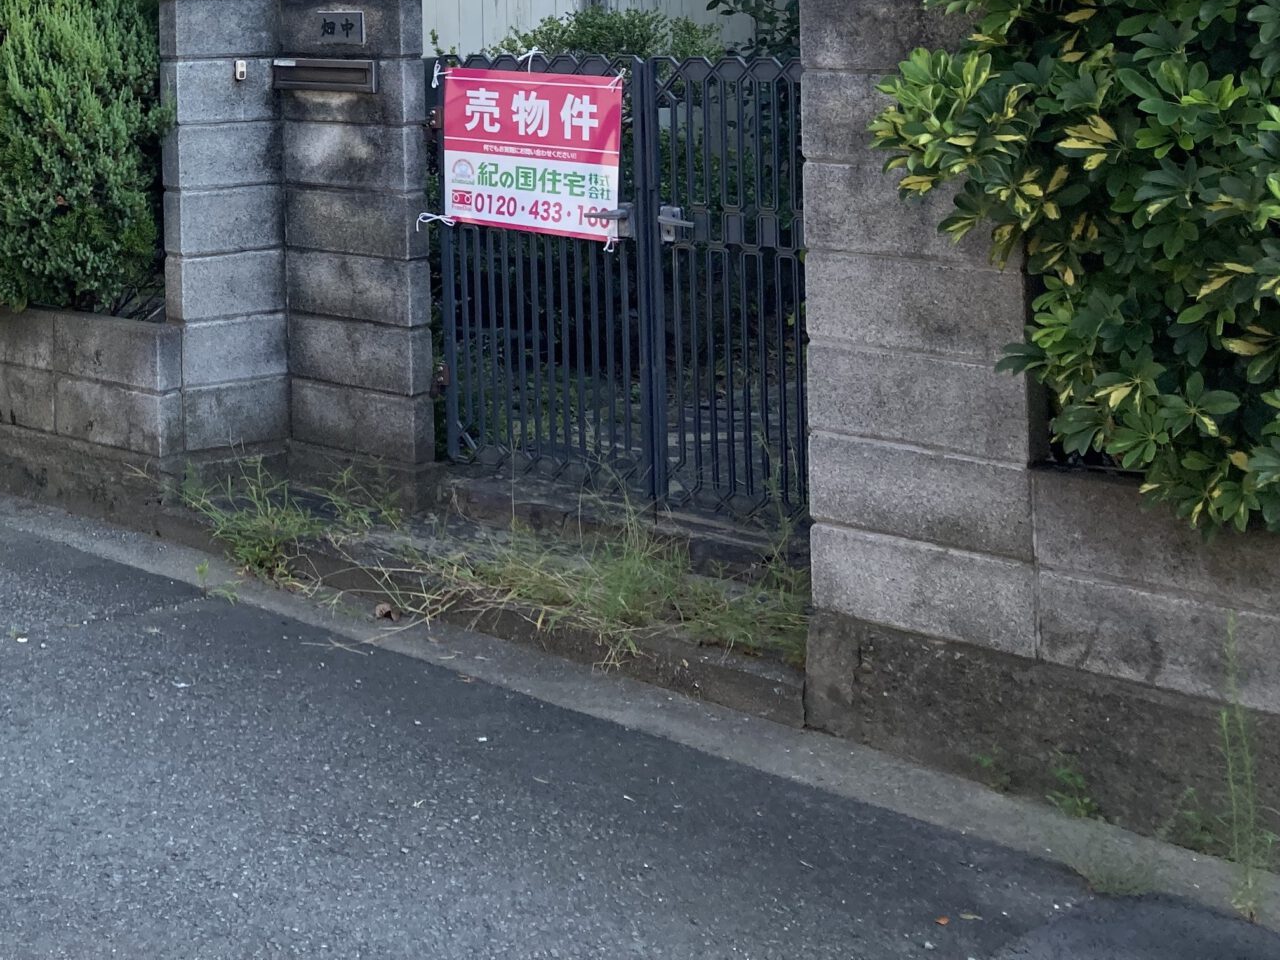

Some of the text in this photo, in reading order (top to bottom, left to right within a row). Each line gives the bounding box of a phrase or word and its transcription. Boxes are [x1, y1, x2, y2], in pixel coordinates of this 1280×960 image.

[464, 87, 599, 142] 売物件
[477, 161, 586, 197] 紀の国住宅
